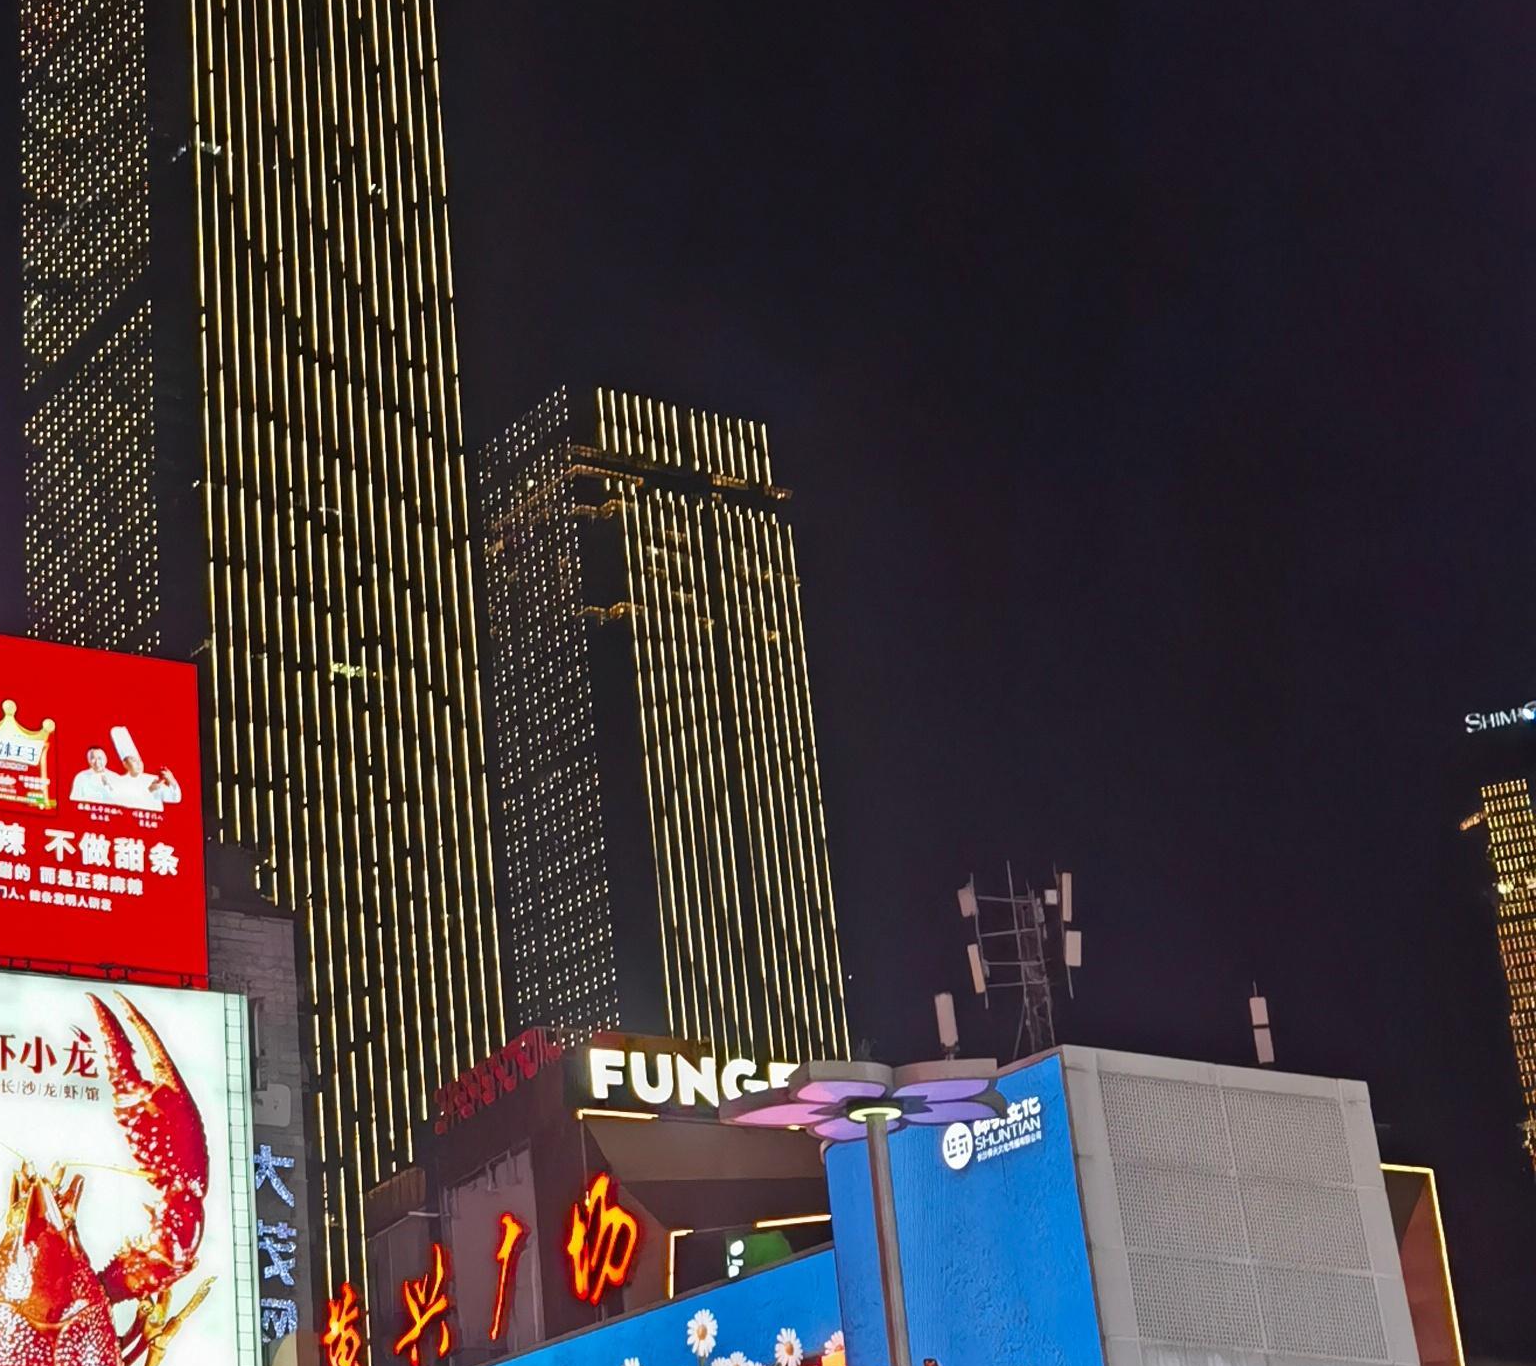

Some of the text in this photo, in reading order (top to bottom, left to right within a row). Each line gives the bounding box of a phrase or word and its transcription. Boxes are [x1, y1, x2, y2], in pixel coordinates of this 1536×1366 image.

[44, 828, 179, 877] 不做甜条
[39, 865, 144, 897] 而是正宗麻辣
[975, 1115, 1041, 1152] SHUNTIAN
